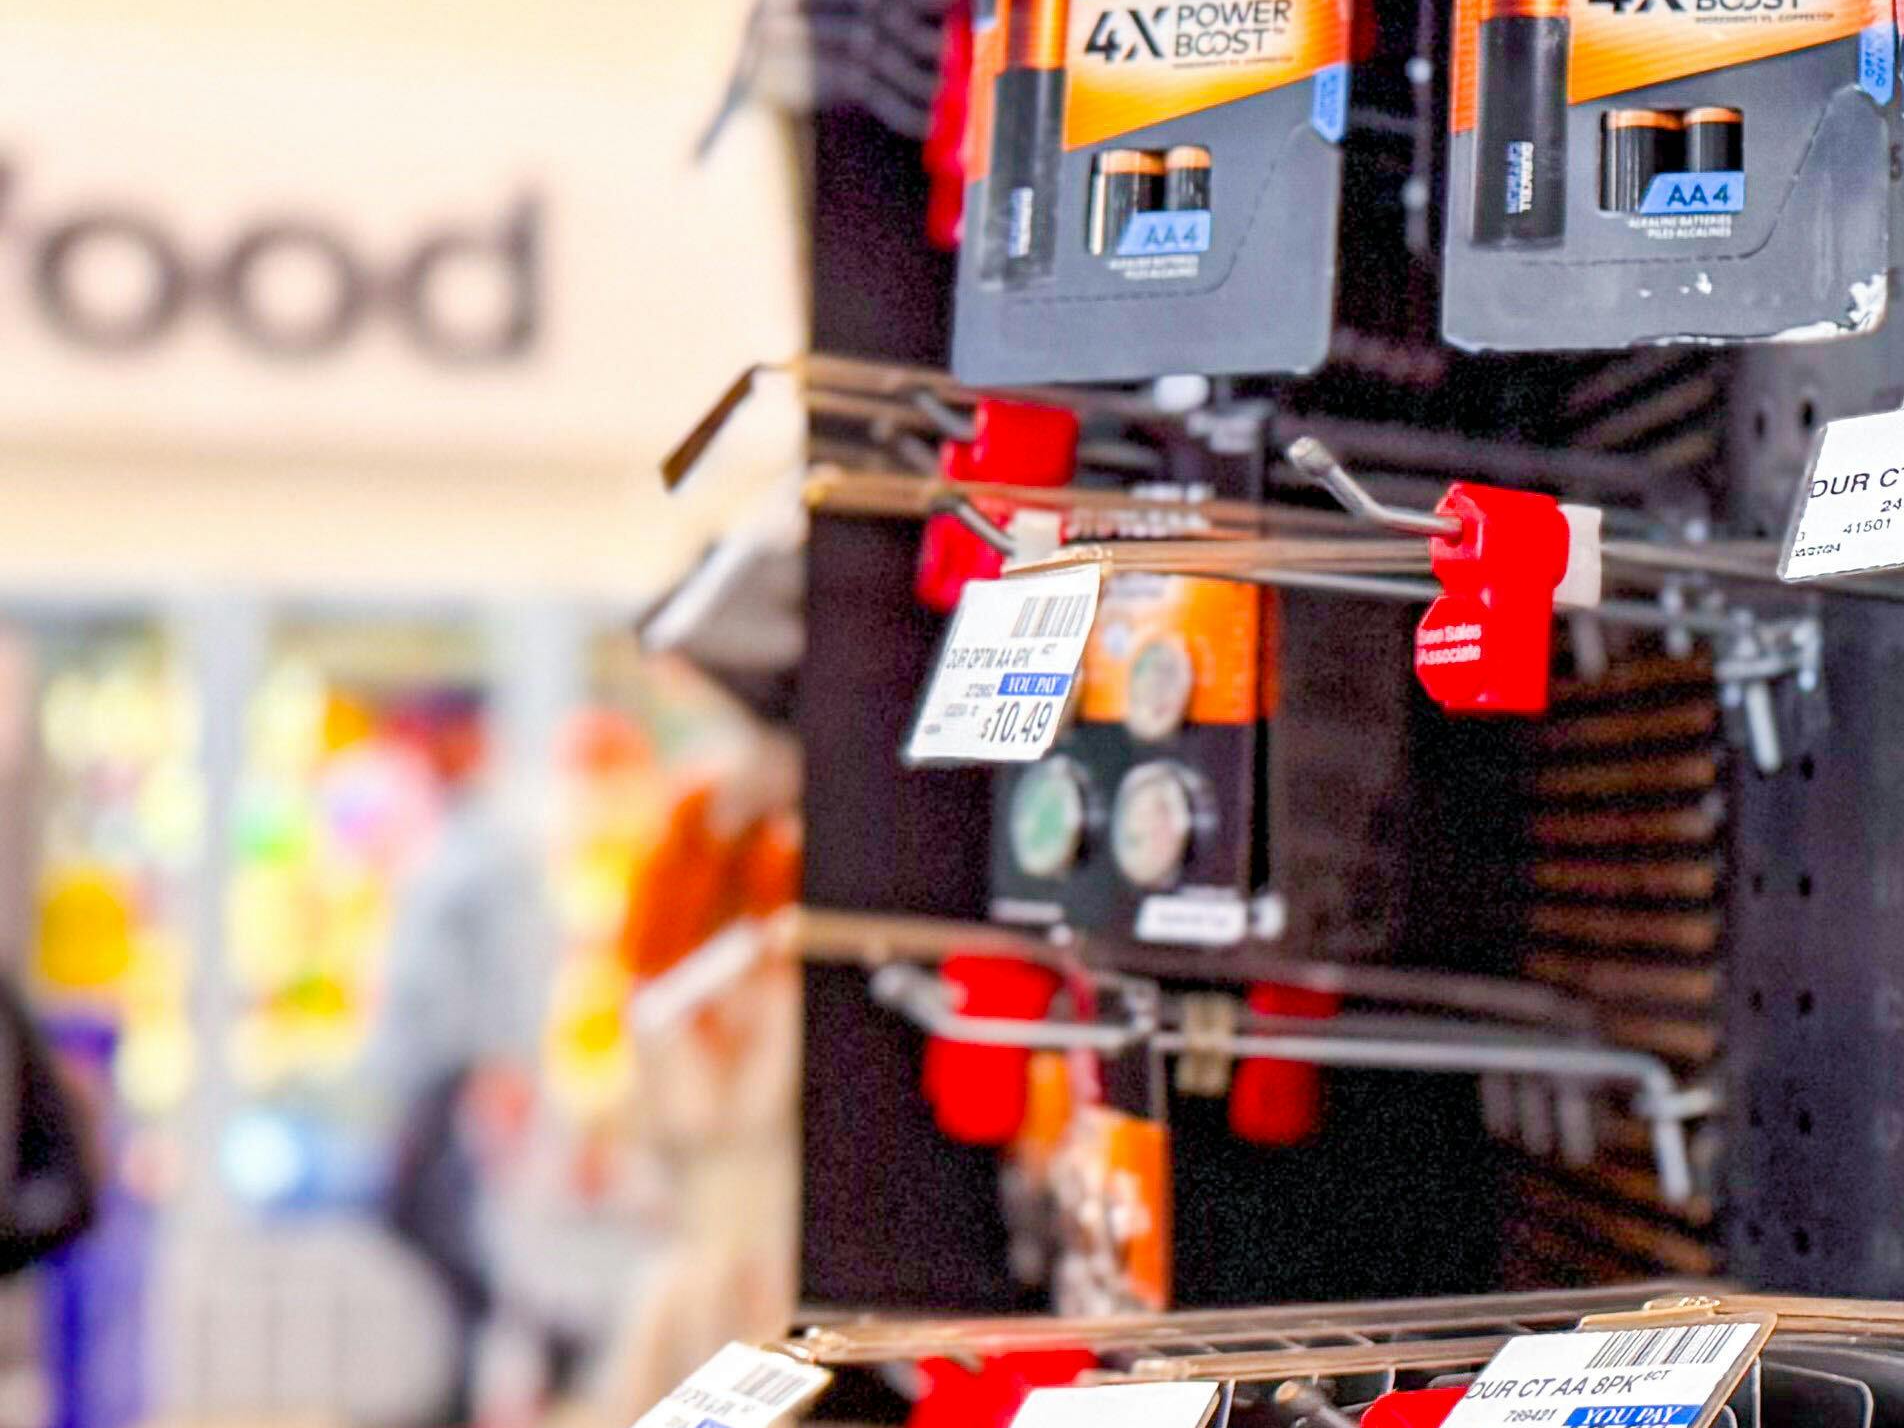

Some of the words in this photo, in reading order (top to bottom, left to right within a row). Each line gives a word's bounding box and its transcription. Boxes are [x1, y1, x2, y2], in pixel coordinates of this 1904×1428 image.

[1084, 5, 1171, 63] 4X
[1174, 28, 1266, 57] BOOST
[0, 140, 547, 373] ood
[980, 701, 1054, 742] $10.49
[1519, 1379, 1553, 1397] CT
[1553, 1378, 1586, 1396] AA
